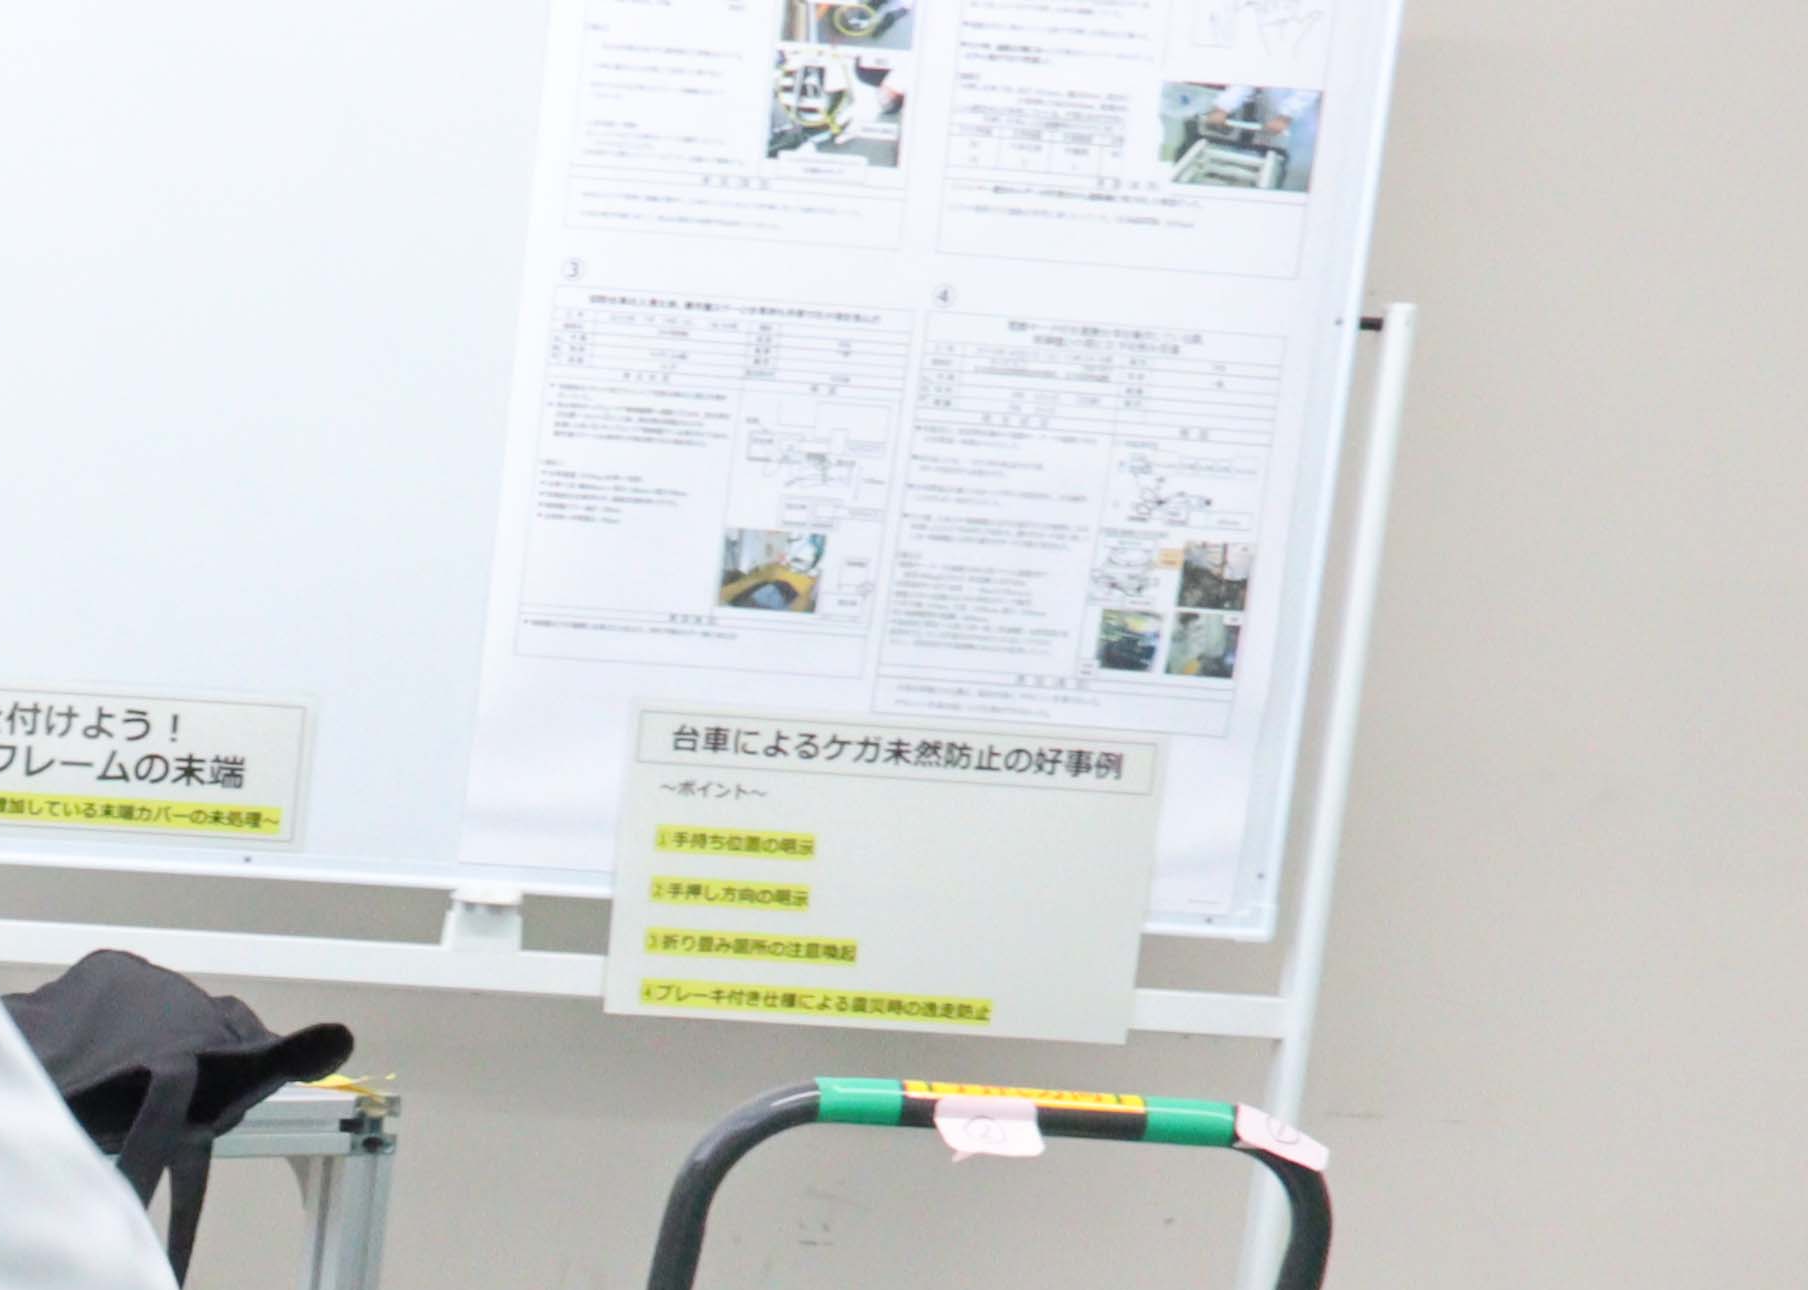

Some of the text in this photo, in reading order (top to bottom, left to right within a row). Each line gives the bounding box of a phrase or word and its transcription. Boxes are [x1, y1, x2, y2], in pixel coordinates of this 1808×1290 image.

[670, 722, 1125, 781] 台車によるケガ未然防止の好事例
